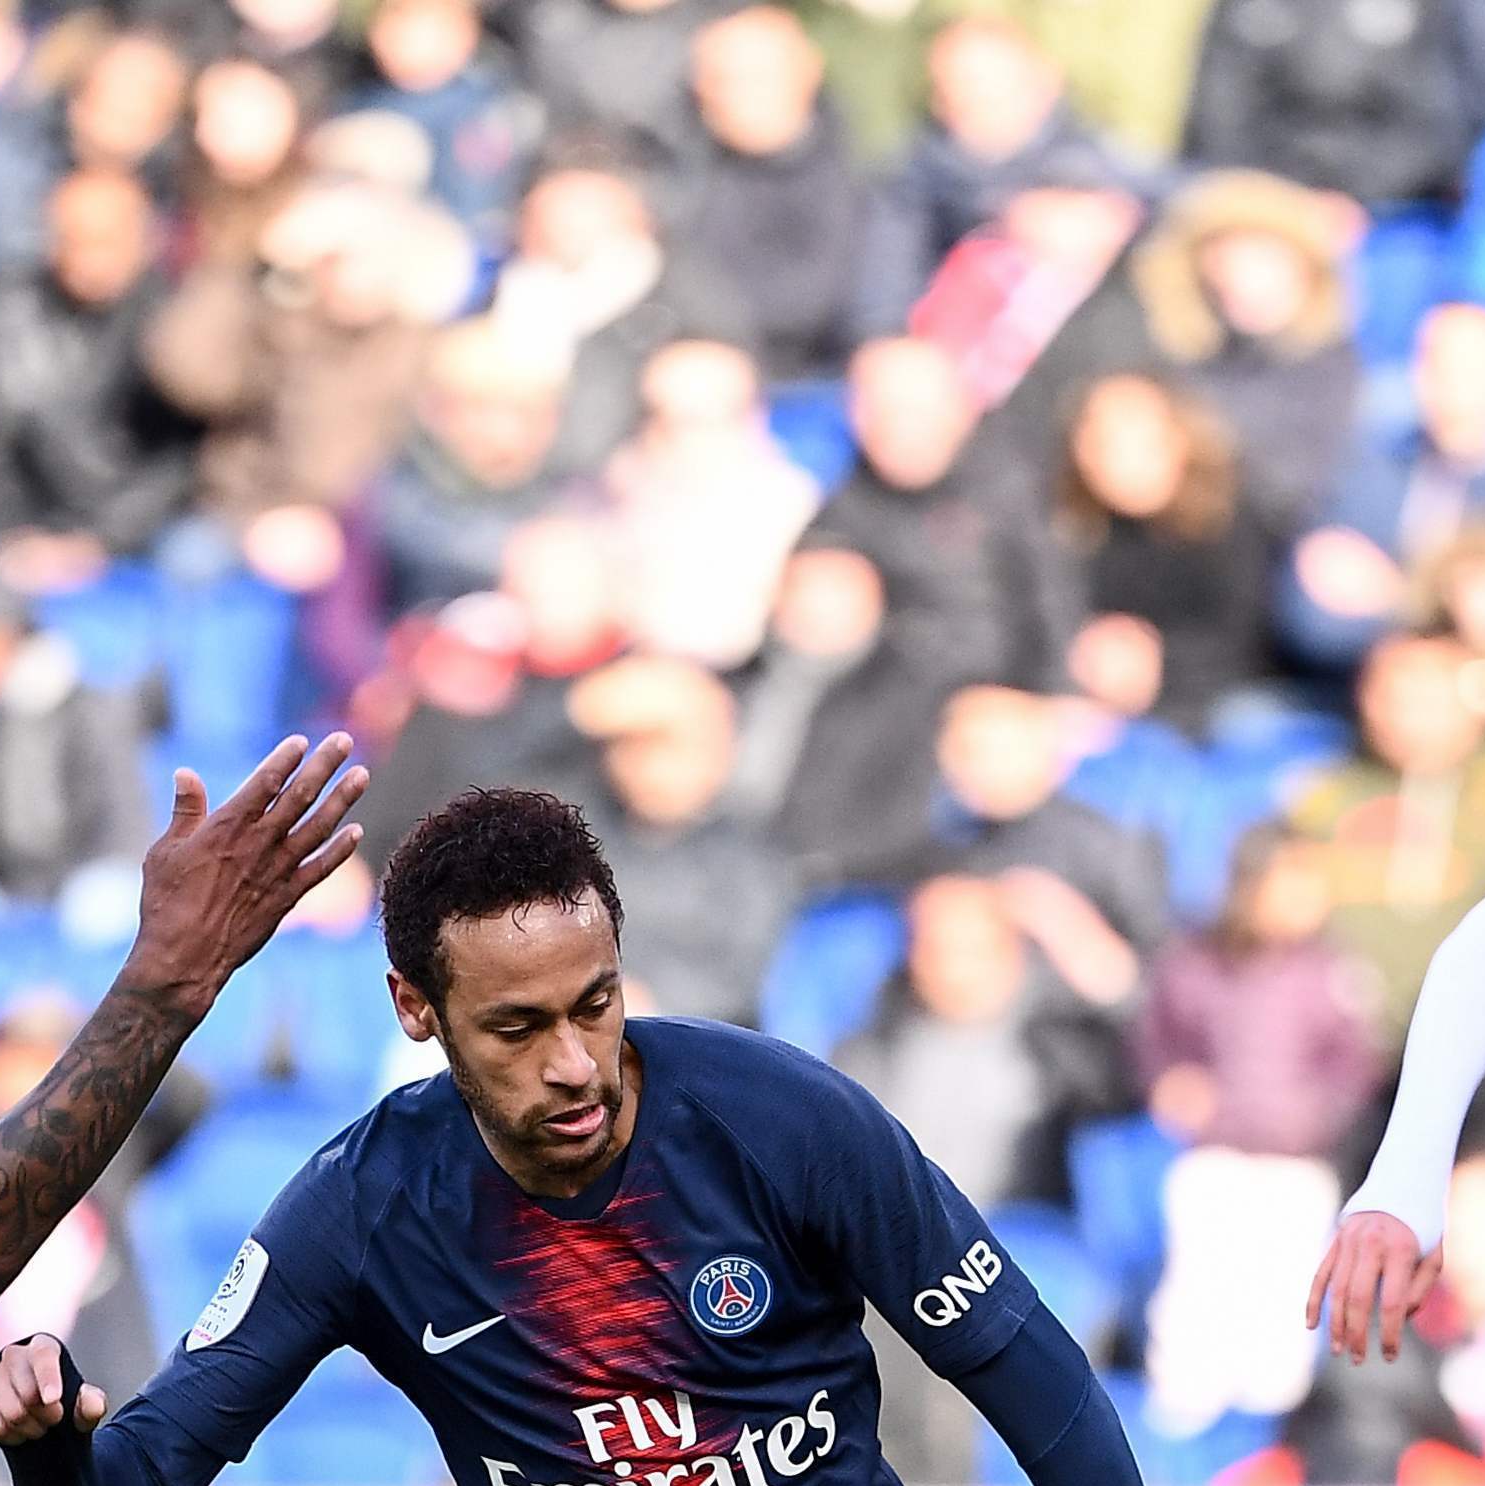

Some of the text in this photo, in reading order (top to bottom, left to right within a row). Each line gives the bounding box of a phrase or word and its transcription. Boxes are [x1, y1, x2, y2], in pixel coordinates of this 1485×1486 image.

[699, 1261, 752, 1286] PARIS
[913, 1240, 1002, 1327] QNB
[573, 1390, 698, 1464] Fly
